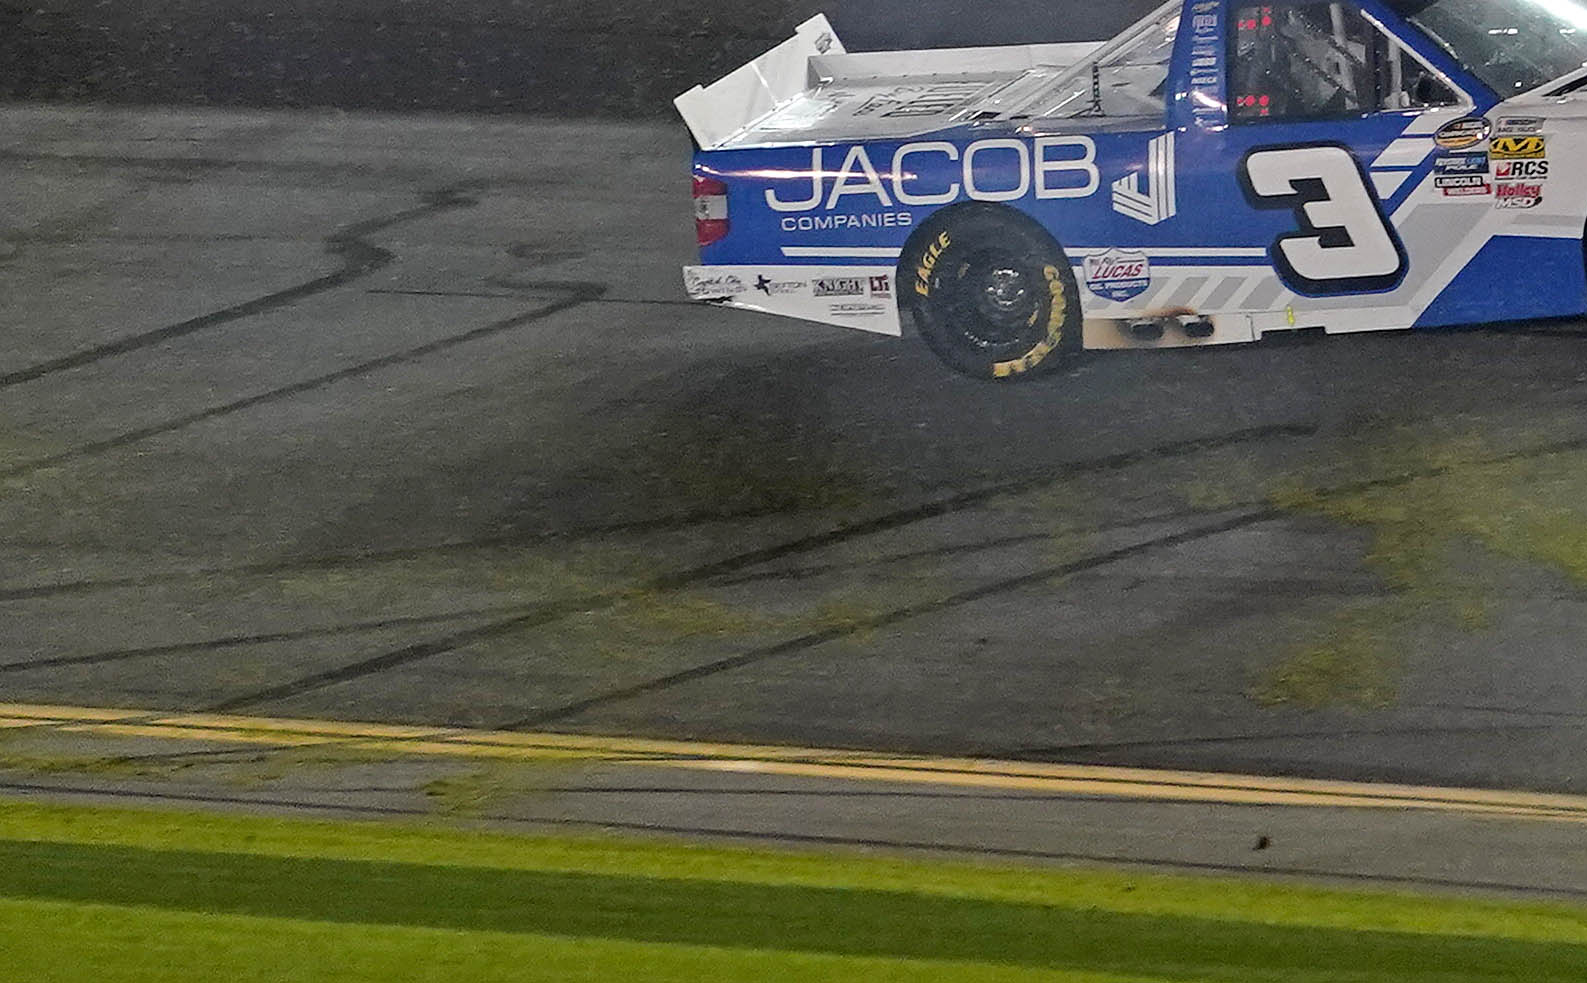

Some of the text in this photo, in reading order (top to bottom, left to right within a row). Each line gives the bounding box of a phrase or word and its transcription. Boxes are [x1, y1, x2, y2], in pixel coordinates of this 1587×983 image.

[764, 135, 1101, 213] JACOB
[1511, 160, 1549, 177] RCS
[781, 211, 913, 233] COMPANIES
[1243, 144, 1405, 289] 3
[914, 230, 951, 297] EAGLE
[1092, 263, 1144, 280] LUCAS
